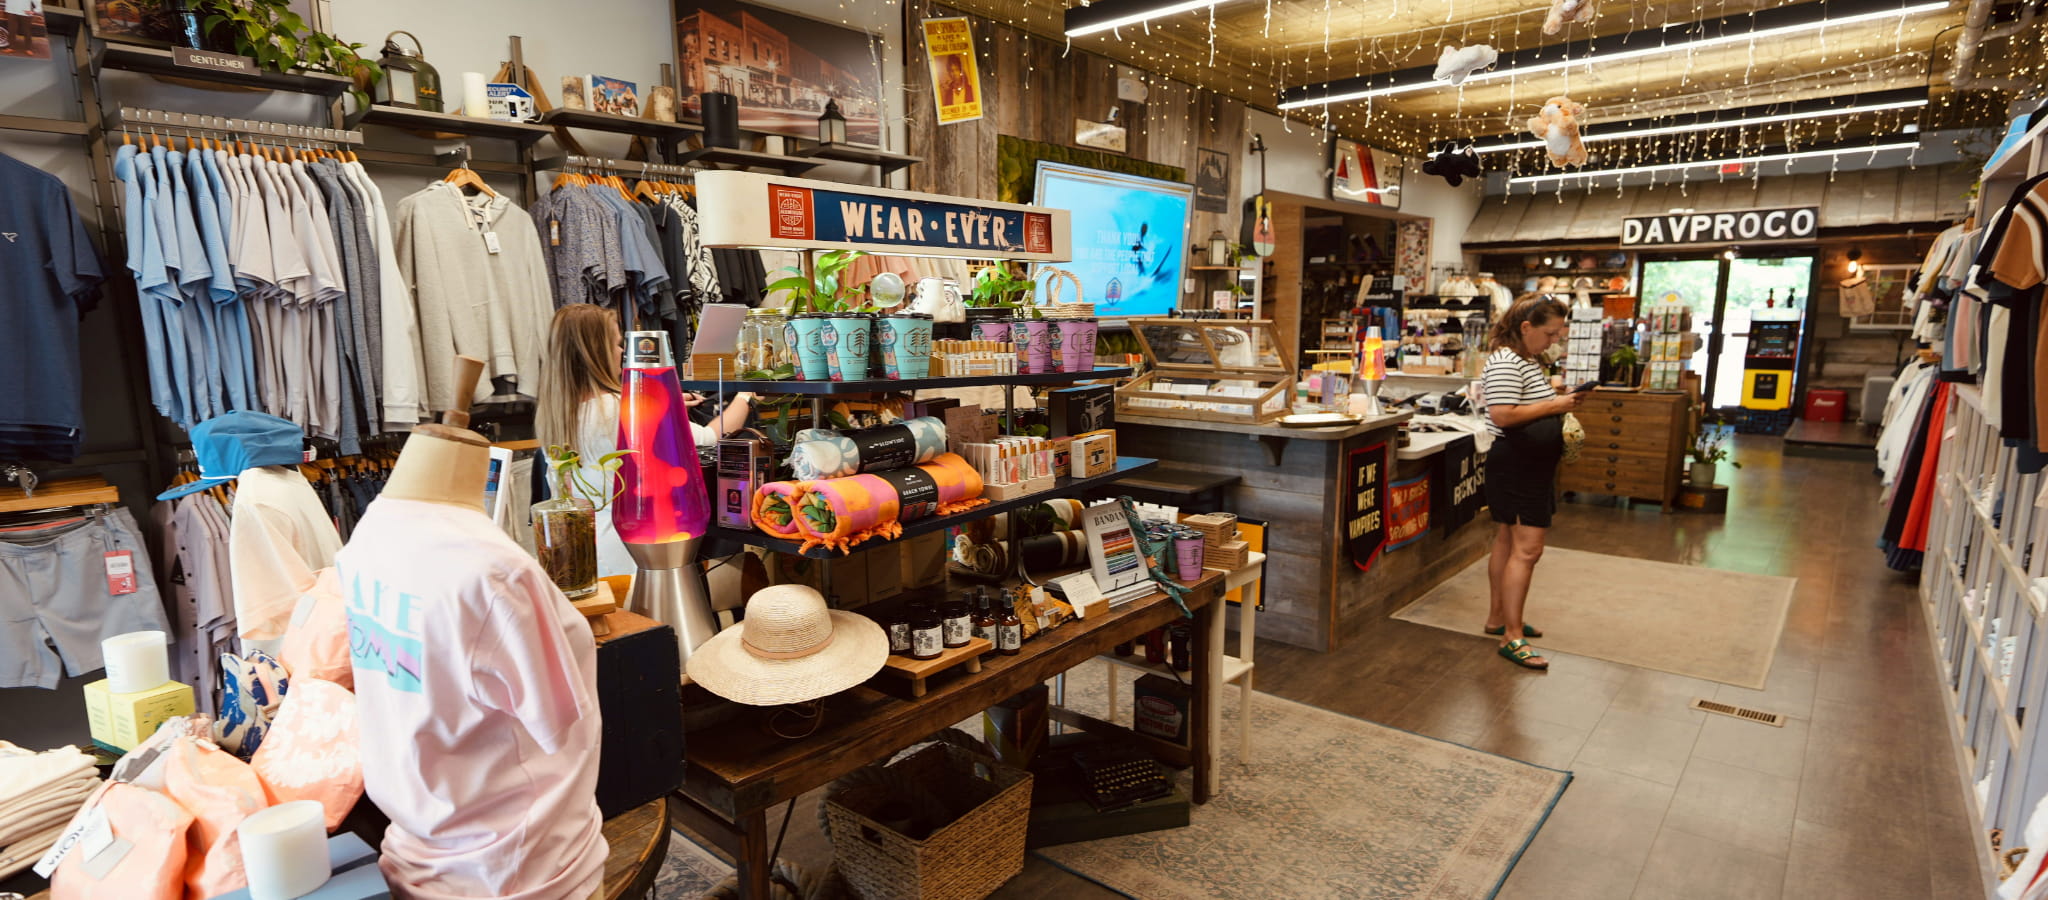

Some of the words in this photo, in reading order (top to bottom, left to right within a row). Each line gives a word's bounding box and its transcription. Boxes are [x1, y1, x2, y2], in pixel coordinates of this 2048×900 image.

[190, 54, 245, 69] GENTLEMEN
[840, 200, 926, 241] WEAR
[945, 211, 1010, 248] EVER
[1623, 209, 1815, 244] DAVPROCO
[1358, 466, 1366, 488] IF
[1366, 463, 1377, 485] WE
[1357, 487, 1375, 512] WERE
[1094, 511, 1126, 526] BANDAN
